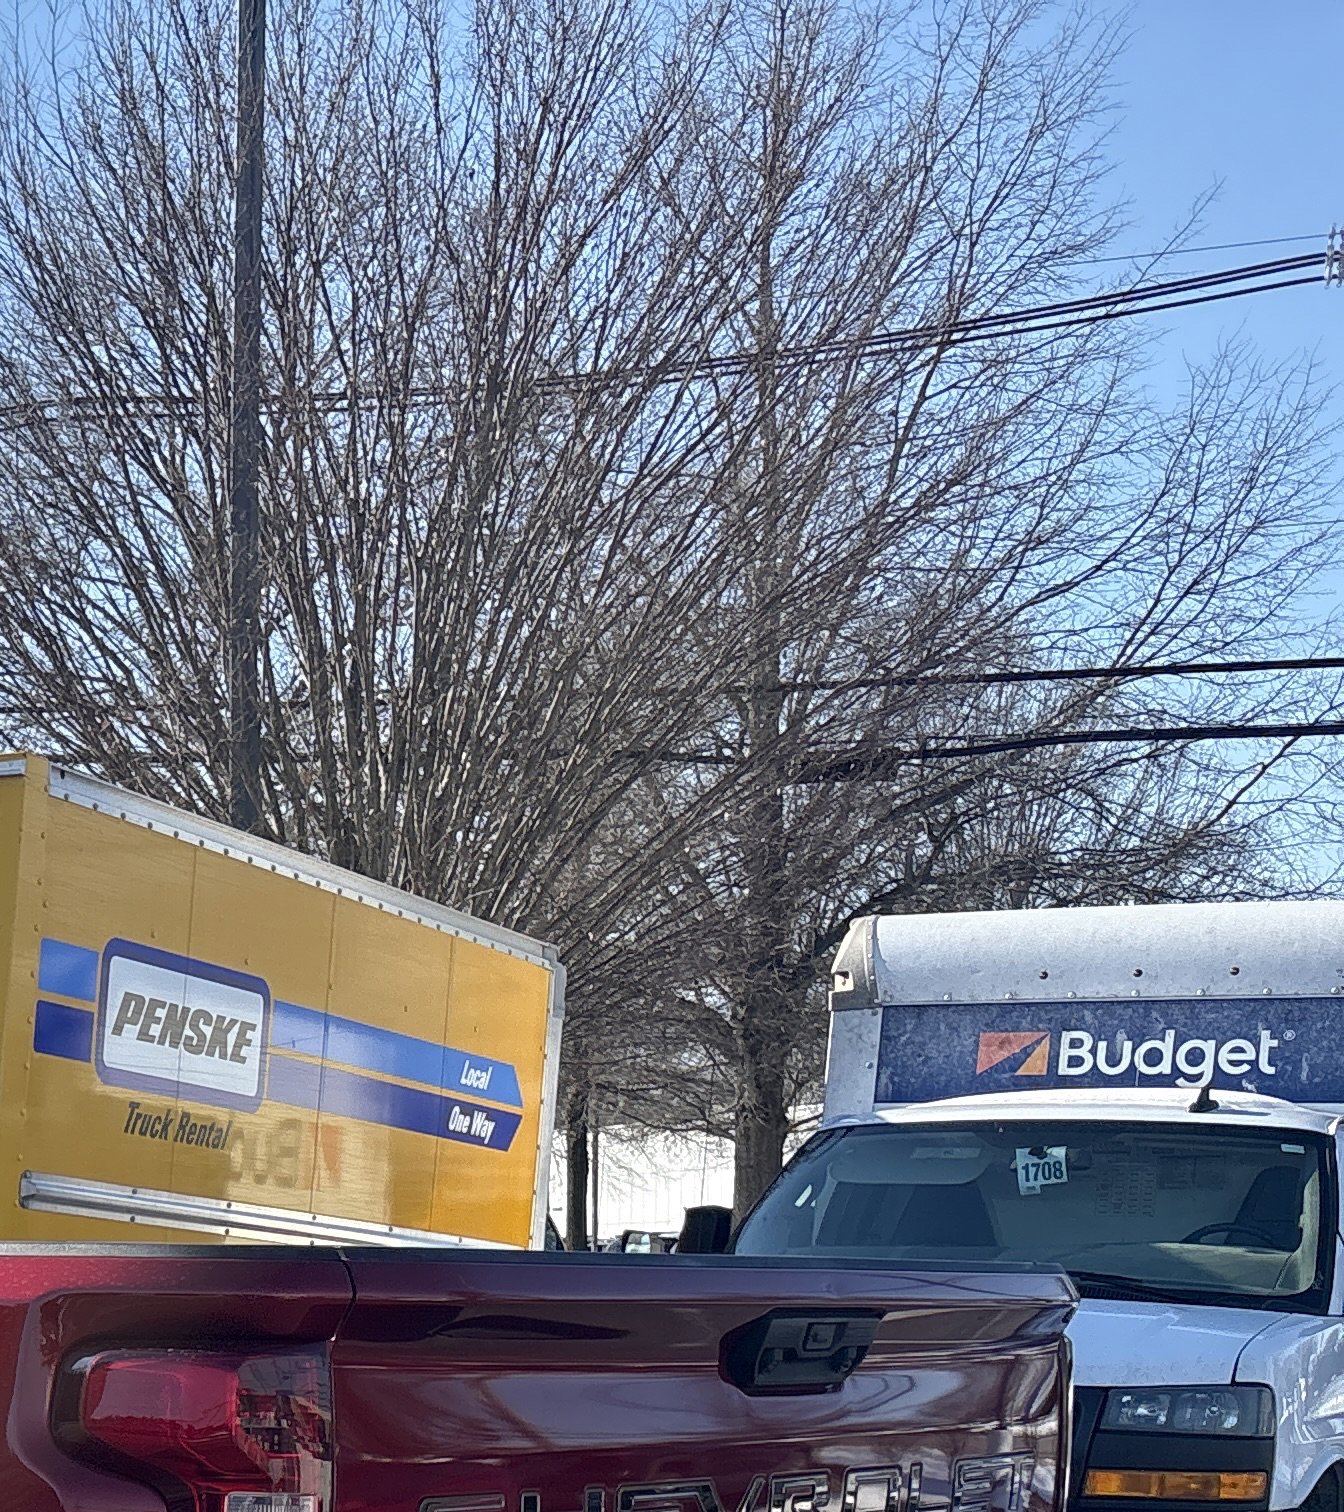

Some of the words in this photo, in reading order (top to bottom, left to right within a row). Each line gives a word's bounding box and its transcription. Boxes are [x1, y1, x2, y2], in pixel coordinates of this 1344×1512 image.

[111, 991, 257, 1064] PENSKE
[460, 1059, 493, 1091] Local
[1057, 1030, 1278, 1088] Budget
[124, 1101, 174, 1141] Truck
[173, 1111, 233, 1150] Rental
[448, 1105, 471, 1134] One
[470, 1110, 496, 1145] Way
[1021, 1161, 1064, 1183] 1708
